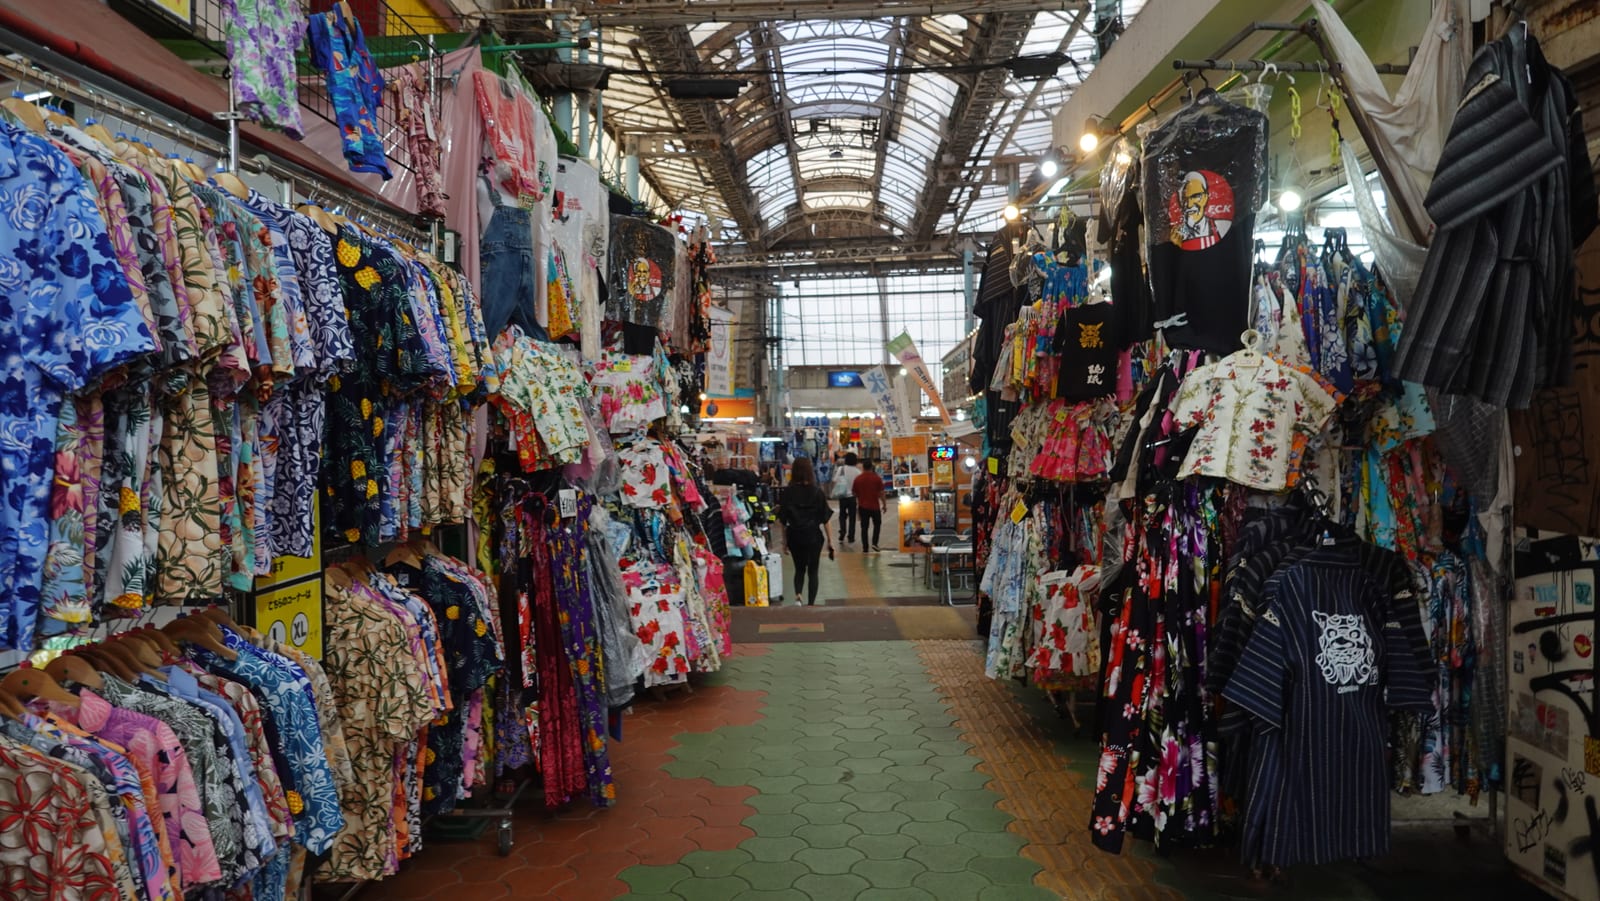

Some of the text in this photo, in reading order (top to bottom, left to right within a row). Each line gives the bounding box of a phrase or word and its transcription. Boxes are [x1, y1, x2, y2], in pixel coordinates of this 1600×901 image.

[268, 589, 312, 610] こちらのコーナーは
[294, 620, 307, 640] XL
